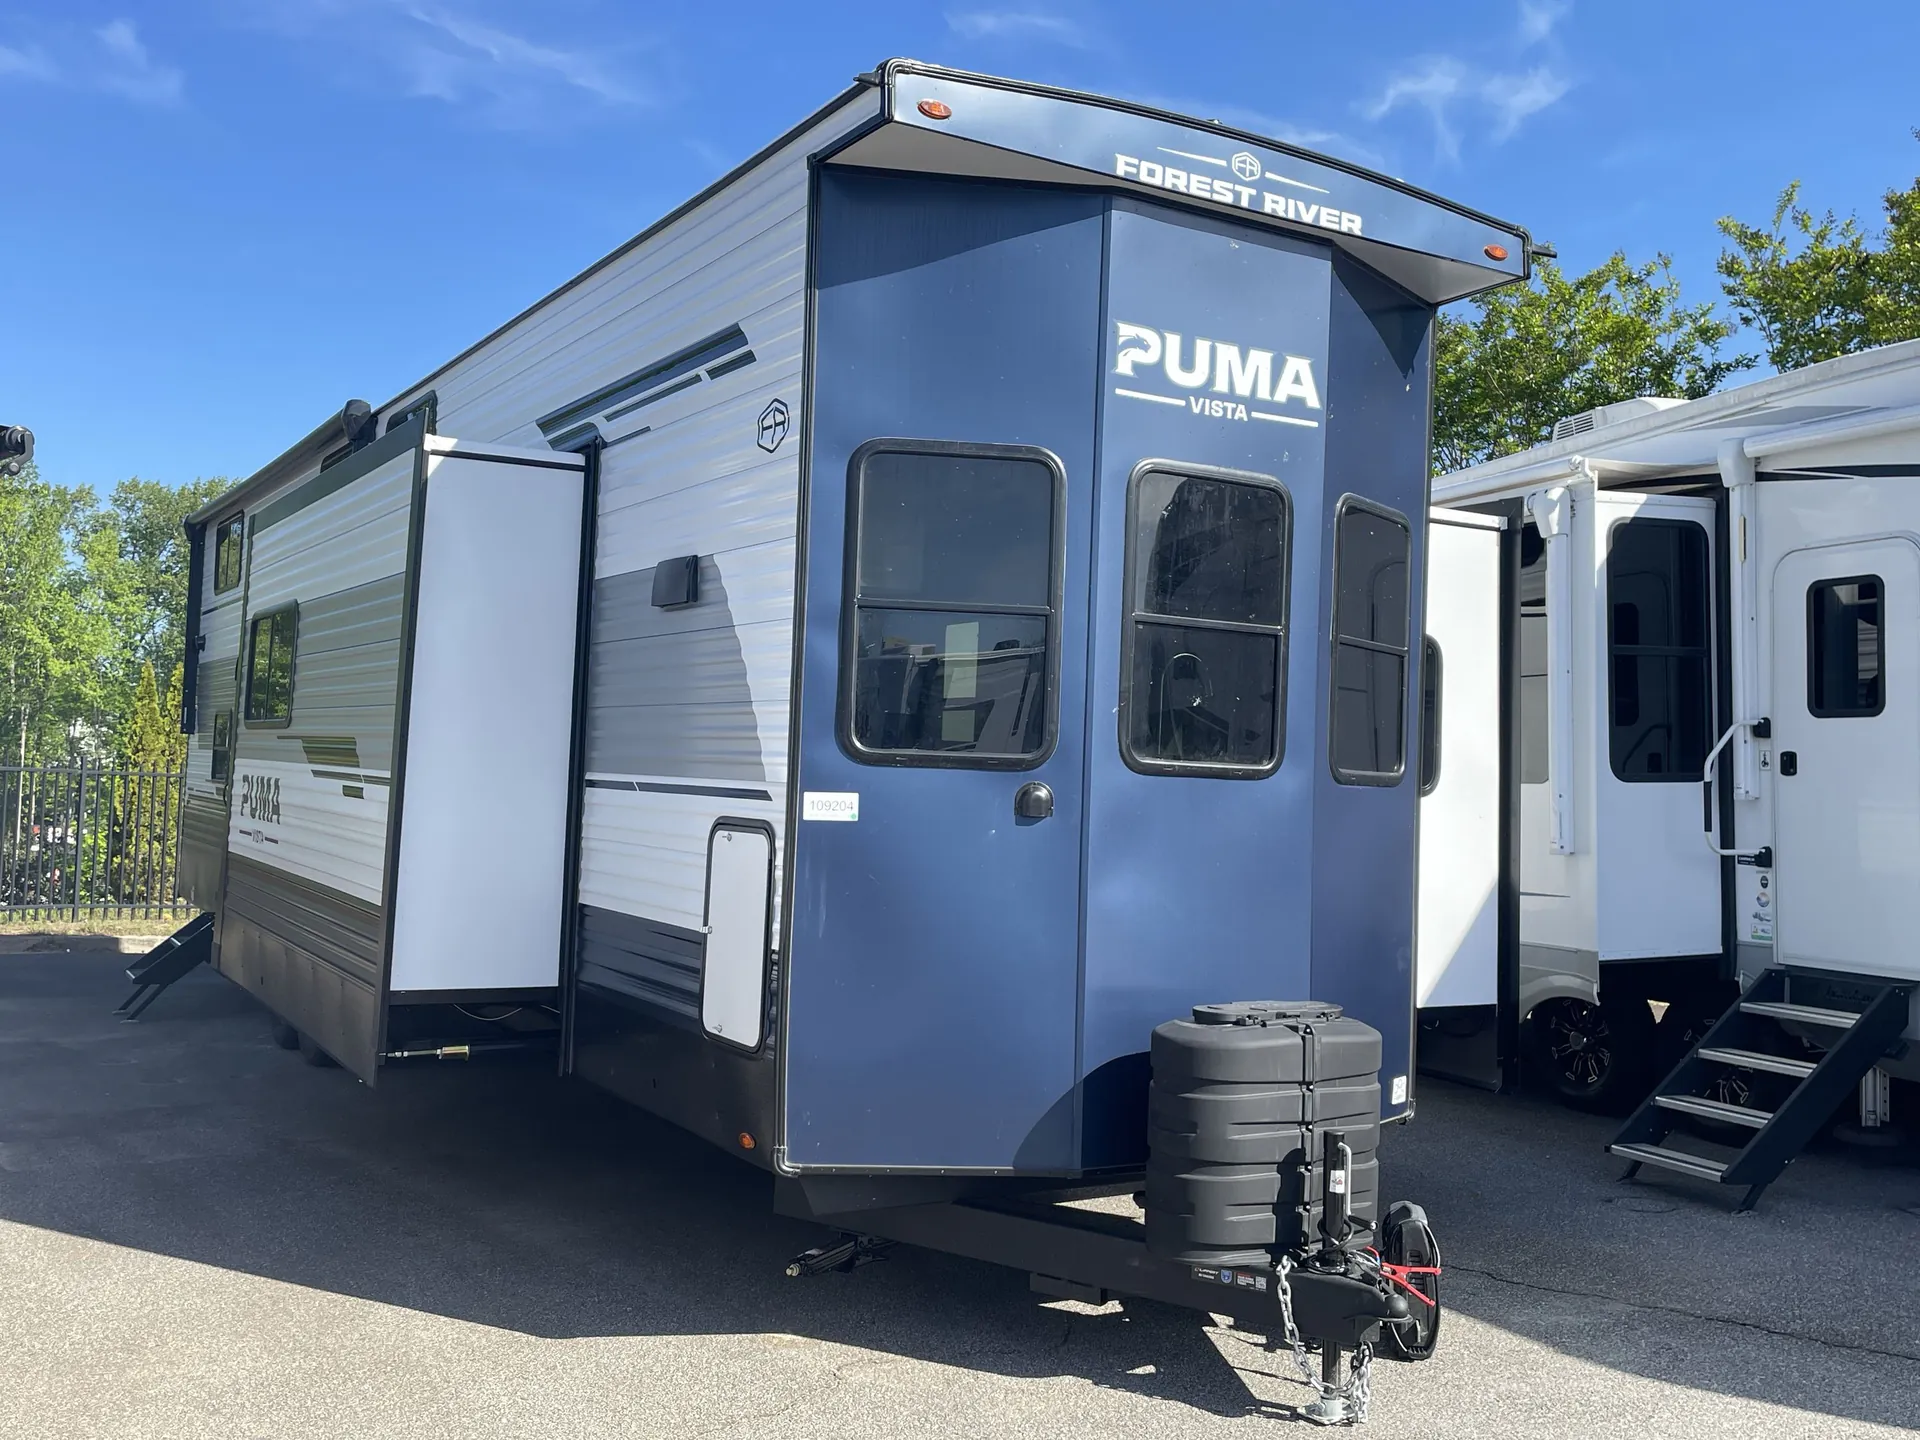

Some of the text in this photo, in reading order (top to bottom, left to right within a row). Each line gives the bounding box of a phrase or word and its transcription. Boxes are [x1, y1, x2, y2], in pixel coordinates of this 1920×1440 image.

[1115, 153, 1362, 236] FOREST RIVER
[1113, 320, 1322, 409] PUMA
[1188, 396, 1249, 422] VISTA
[240, 774, 281, 825] PUMA
[810, 799, 854, 812] 109204
